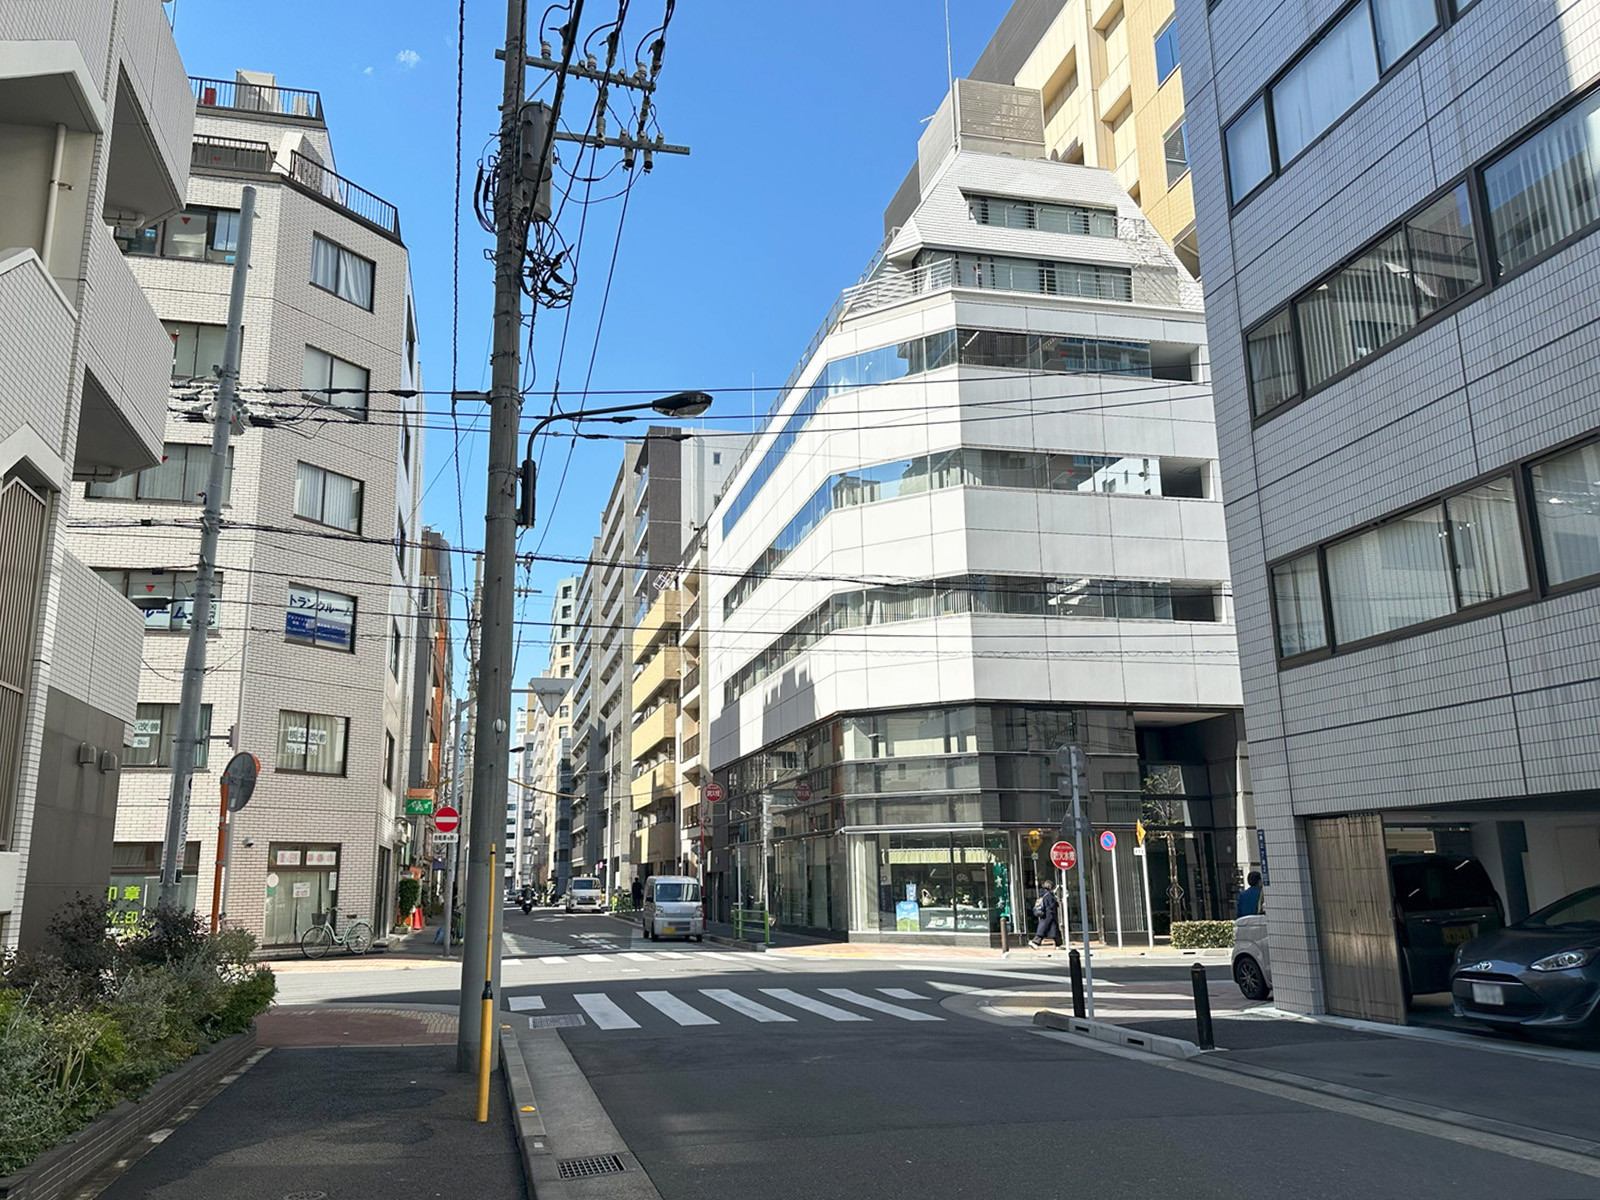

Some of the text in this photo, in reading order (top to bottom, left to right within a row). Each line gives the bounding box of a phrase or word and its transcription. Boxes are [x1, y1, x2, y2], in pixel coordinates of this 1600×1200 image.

[289, 594, 353, 616] トランクルーム
[1051, 850, 1076, 861] 防火水槽
